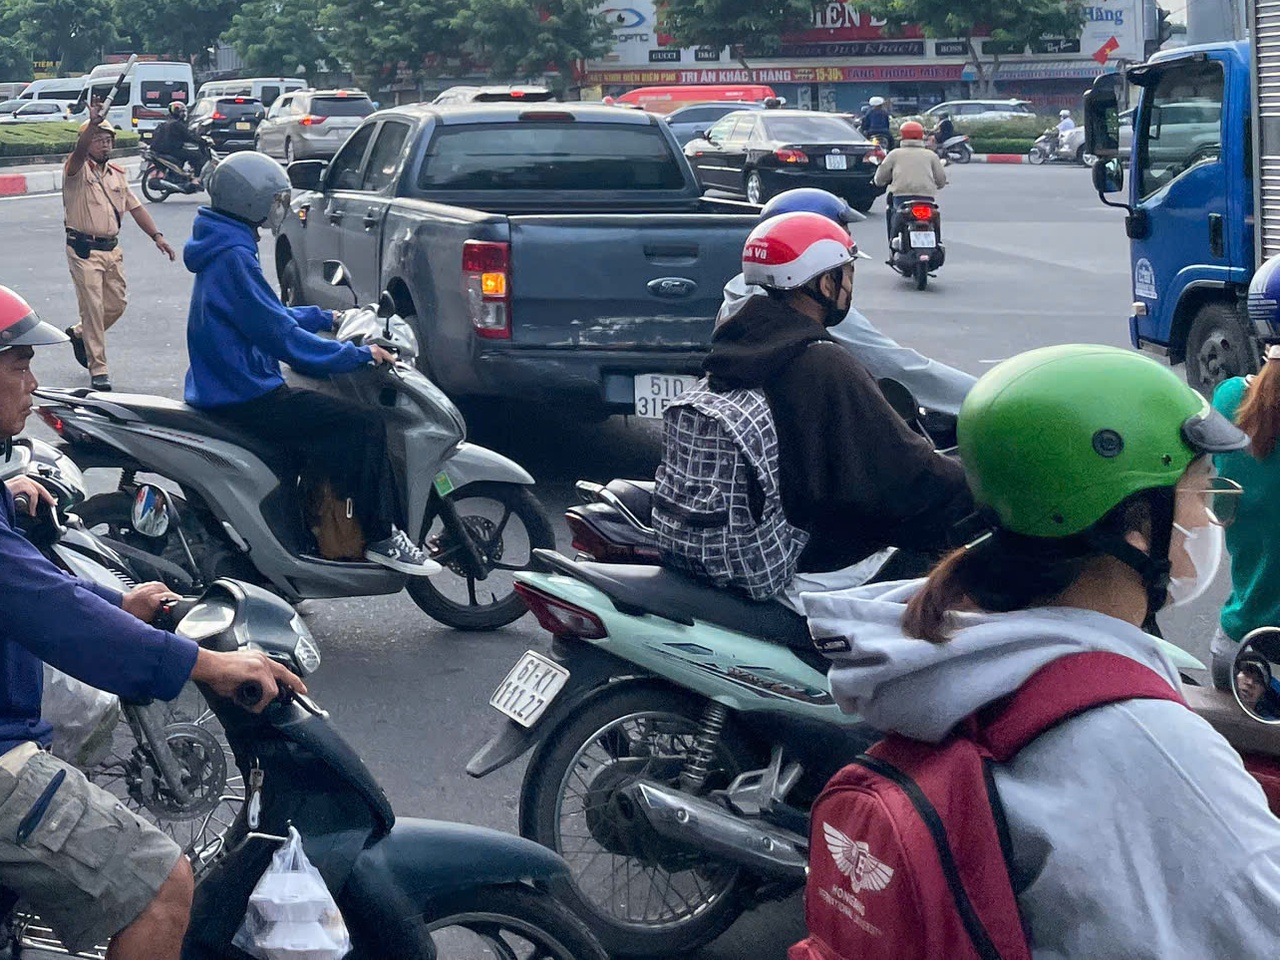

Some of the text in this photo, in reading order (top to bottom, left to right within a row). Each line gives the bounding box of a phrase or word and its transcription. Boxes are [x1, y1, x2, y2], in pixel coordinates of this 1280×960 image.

[941, 45, 963, 53] BOSS
[652, 52, 677, 60] GUCCI
[698, 51, 716, 59] D&G
[681, 72, 698, 83] TRI
[650, 376, 684, 396] 51D
[496, 681, 544, 721] 111.27
